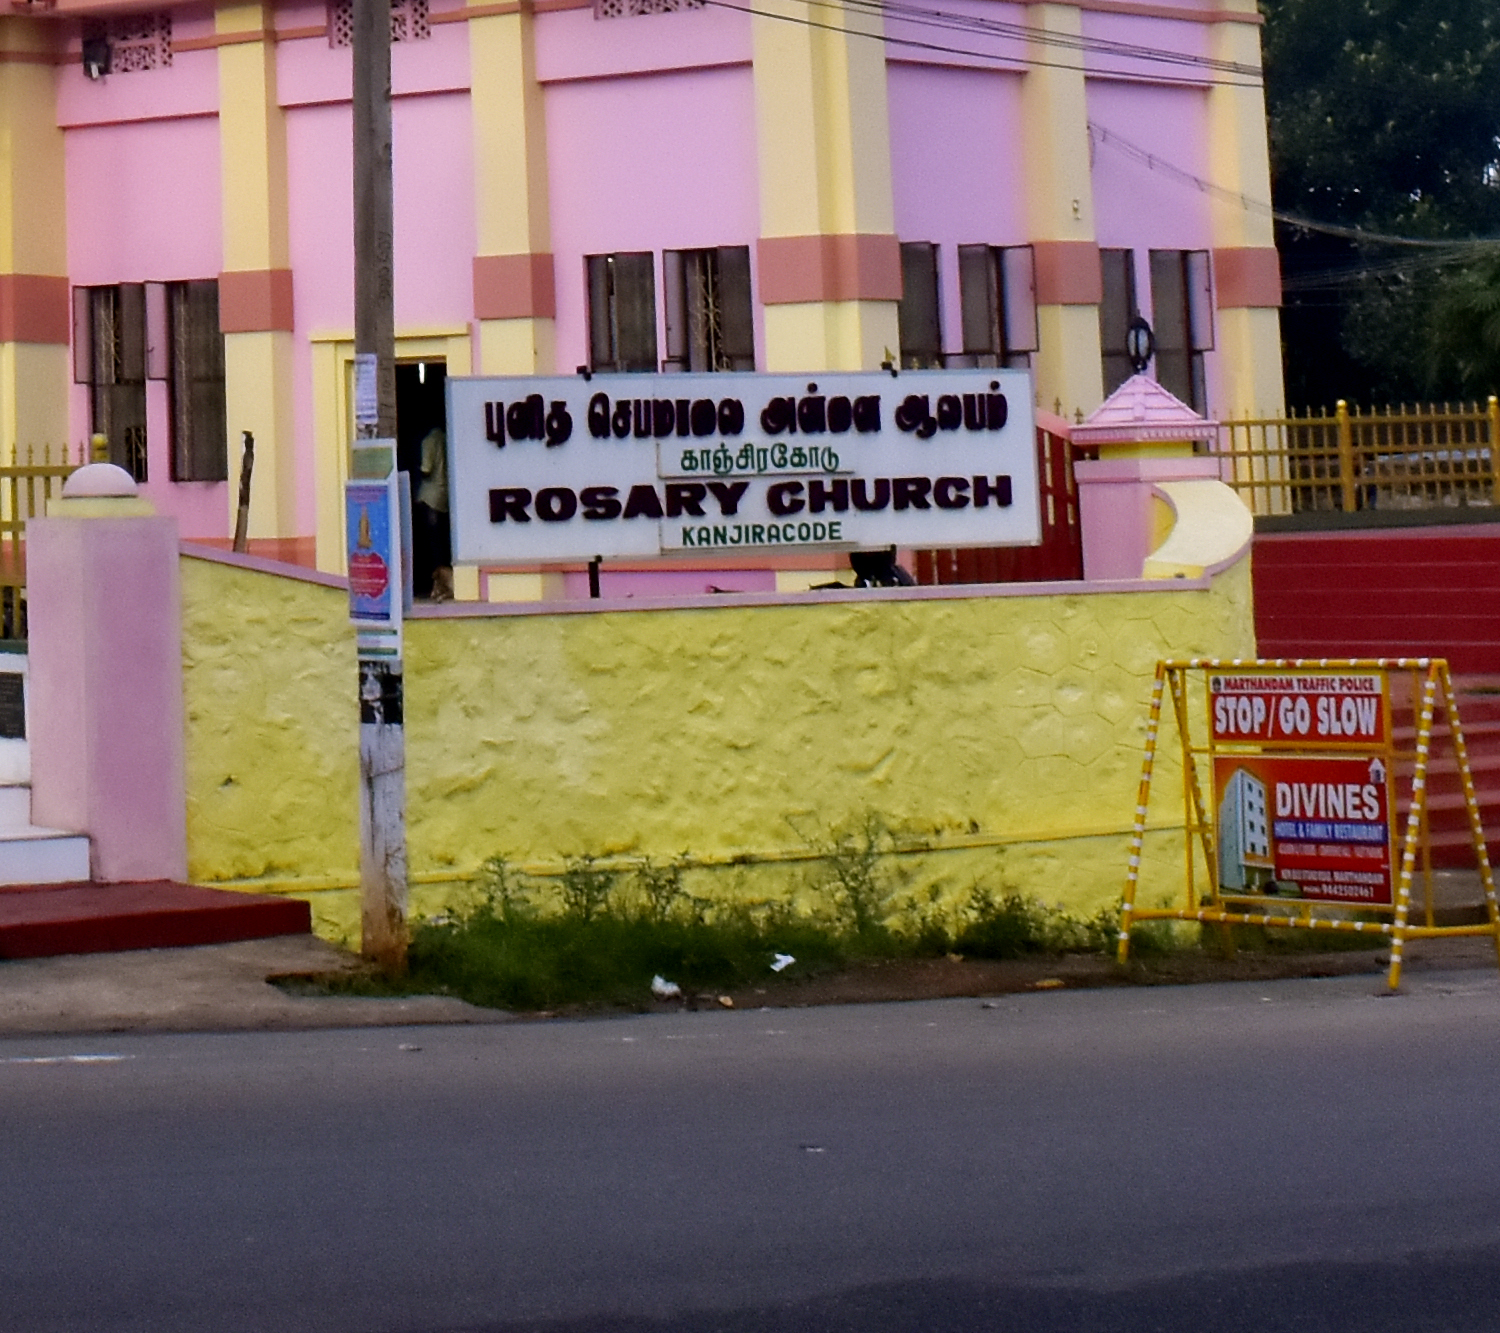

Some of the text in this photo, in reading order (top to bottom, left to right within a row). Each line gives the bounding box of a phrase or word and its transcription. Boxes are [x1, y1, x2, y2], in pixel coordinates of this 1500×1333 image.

[484, 380, 1008, 448] புனித செபமாலை அன்னை ஆலயம்
[681, 442, 840, 475] காஞ்சிரகோடு
[489, 475, 1012, 523] ROSARY CHURCH
[682, 521, 842, 546] KANJIRACODE
[1224, 677, 1374, 691] MARTHANDAM TRAFFIC POLICE
[1316, 696, 1378, 735] SLOW
[1276, 782, 1380, 820] DIVINES
